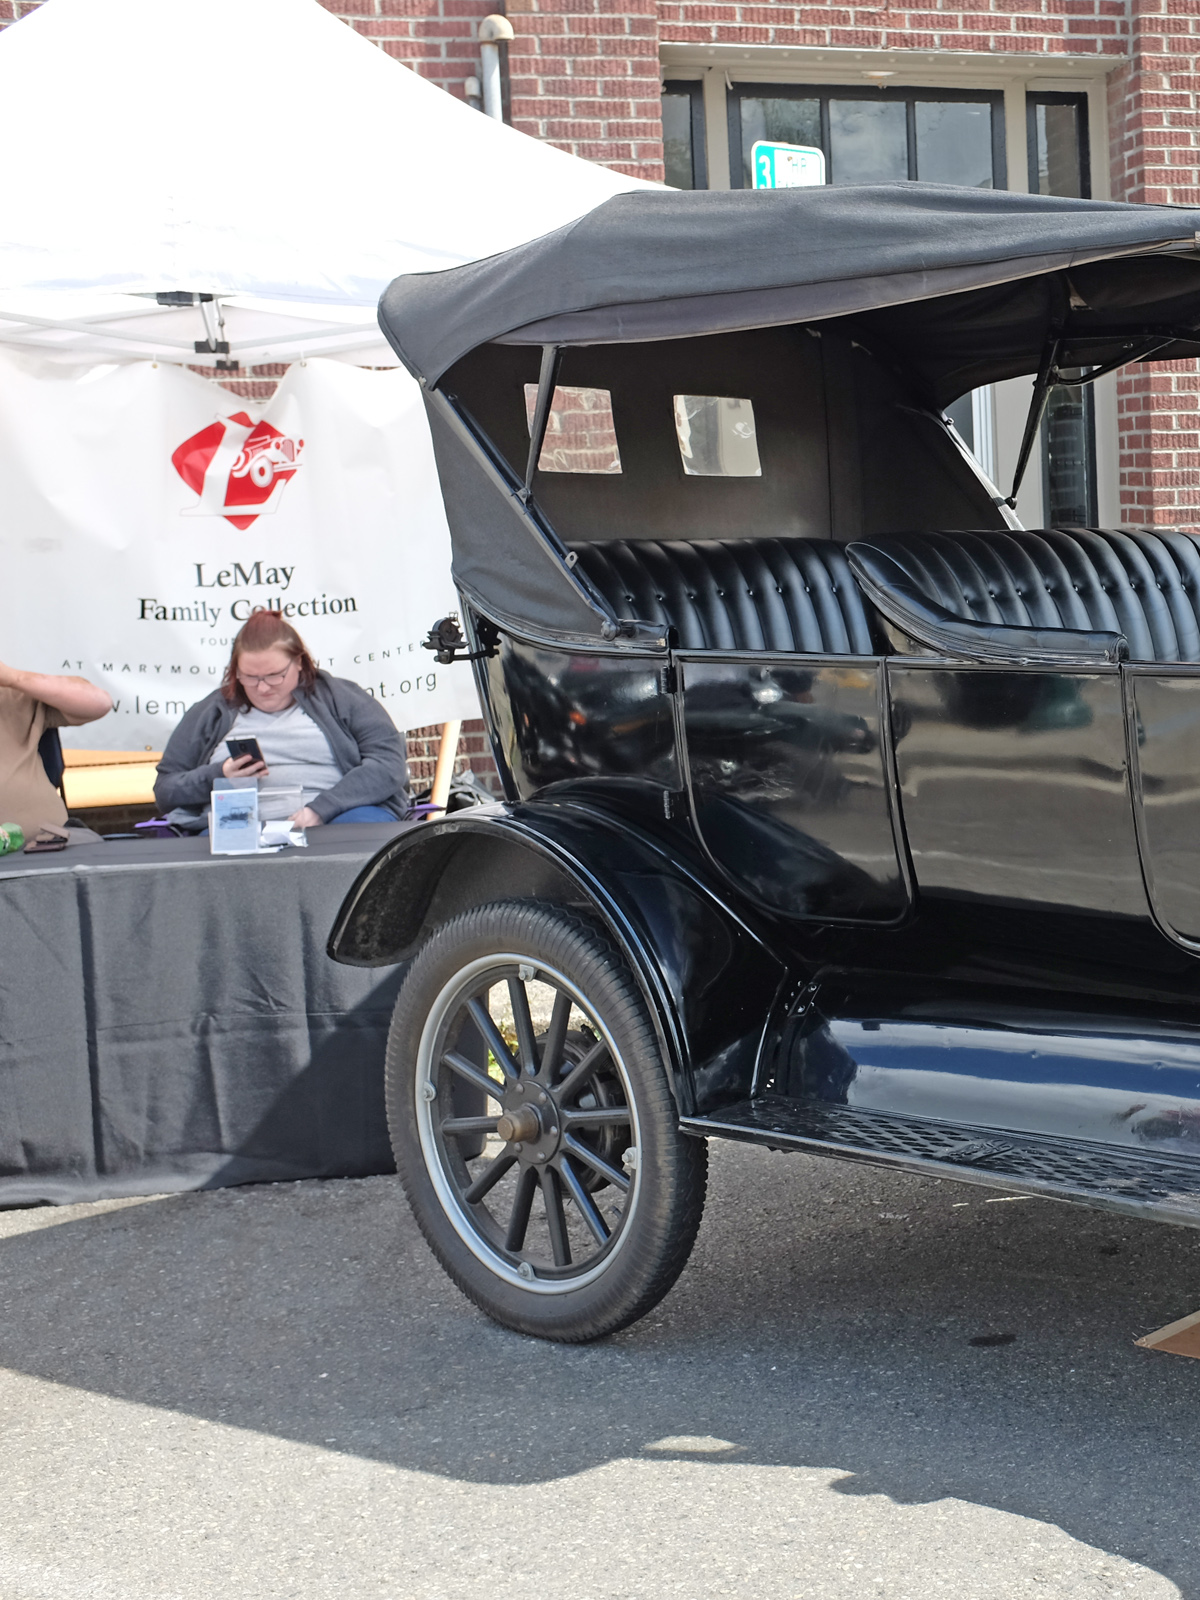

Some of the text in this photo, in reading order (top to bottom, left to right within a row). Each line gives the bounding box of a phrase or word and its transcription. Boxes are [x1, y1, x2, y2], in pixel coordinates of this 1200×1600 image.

[193, 561, 295, 590] LeMay
[137, 593, 358, 627] Family Collection
[62, 659, 84, 670] AT
[102, 662, 228, 676] MARYMOU
